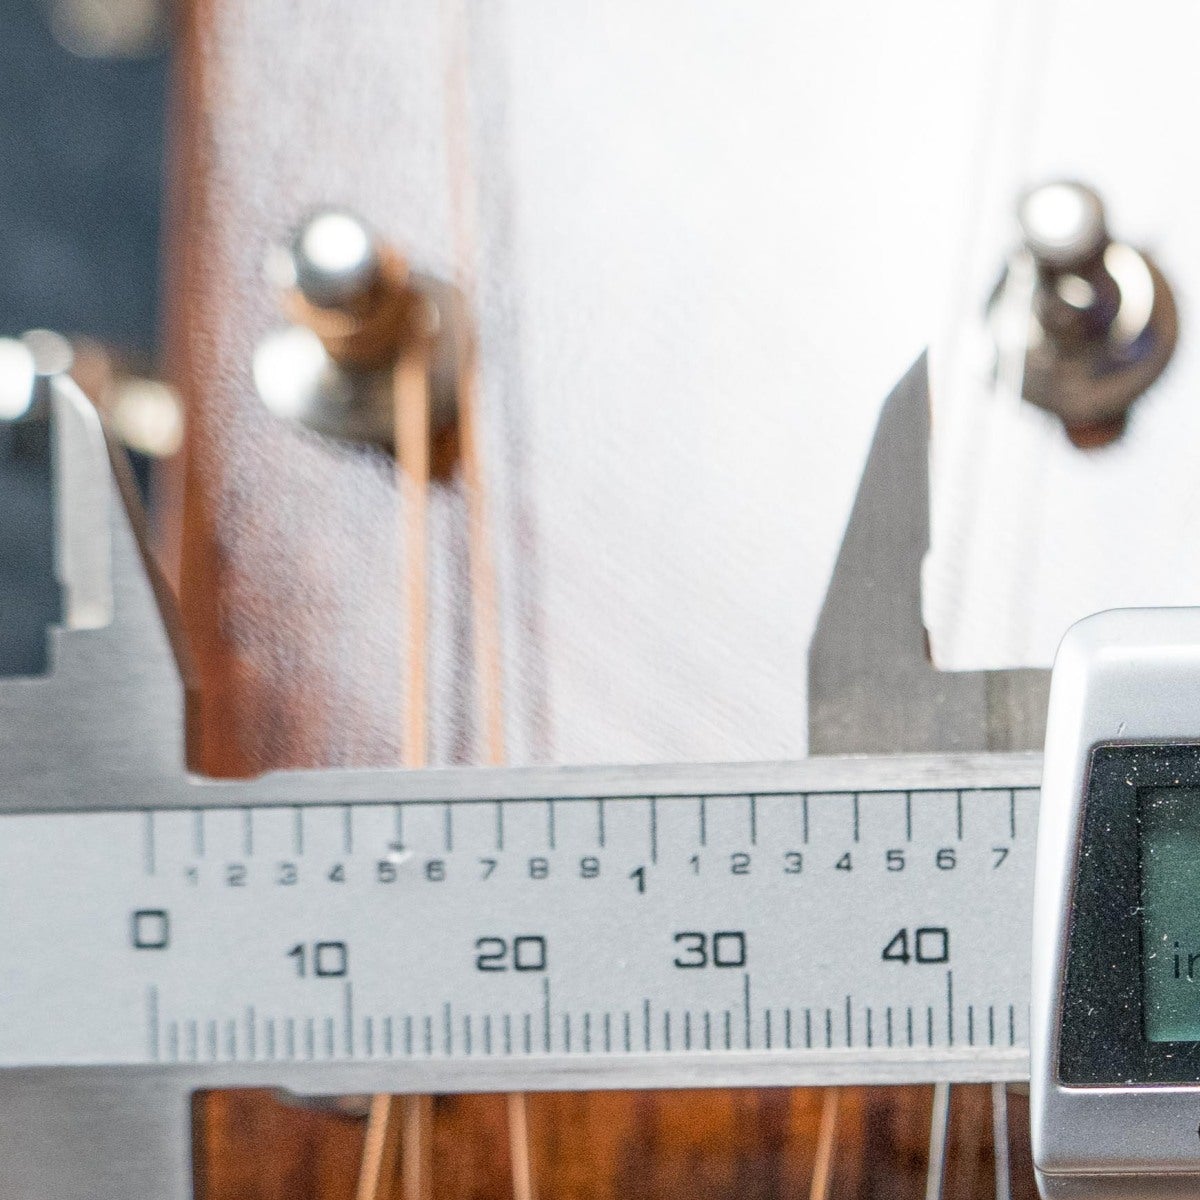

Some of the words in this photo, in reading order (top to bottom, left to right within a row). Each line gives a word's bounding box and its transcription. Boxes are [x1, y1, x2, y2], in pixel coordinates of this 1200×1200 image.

[226, 864, 248, 887] 2
[276, 863, 298, 886] 3
[327, 863, 346, 884] 4
[376, 861, 398, 883] 5
[424, 859, 446, 882] 6
[479, 859, 499, 880] 7
[528, 857, 549, 880] 8
[579, 856, 600, 879] 9
[629, 867, 646, 894] 1
[688, 855, 700, 874] 1
[730, 853, 751, 875] 2
[783, 852, 803, 874] 3
[835, 852, 854, 872] 4
[886, 849, 906, 872] 5
[935, 847, 957, 870] 6
[991, 847, 1010, 870] 7
[131, 909, 169, 950] 0
[286, 941, 348, 979] 10
[475, 935, 547, 973] 20
[672, 931, 746, 969] 30
[881, 927, 950, 966] 40
